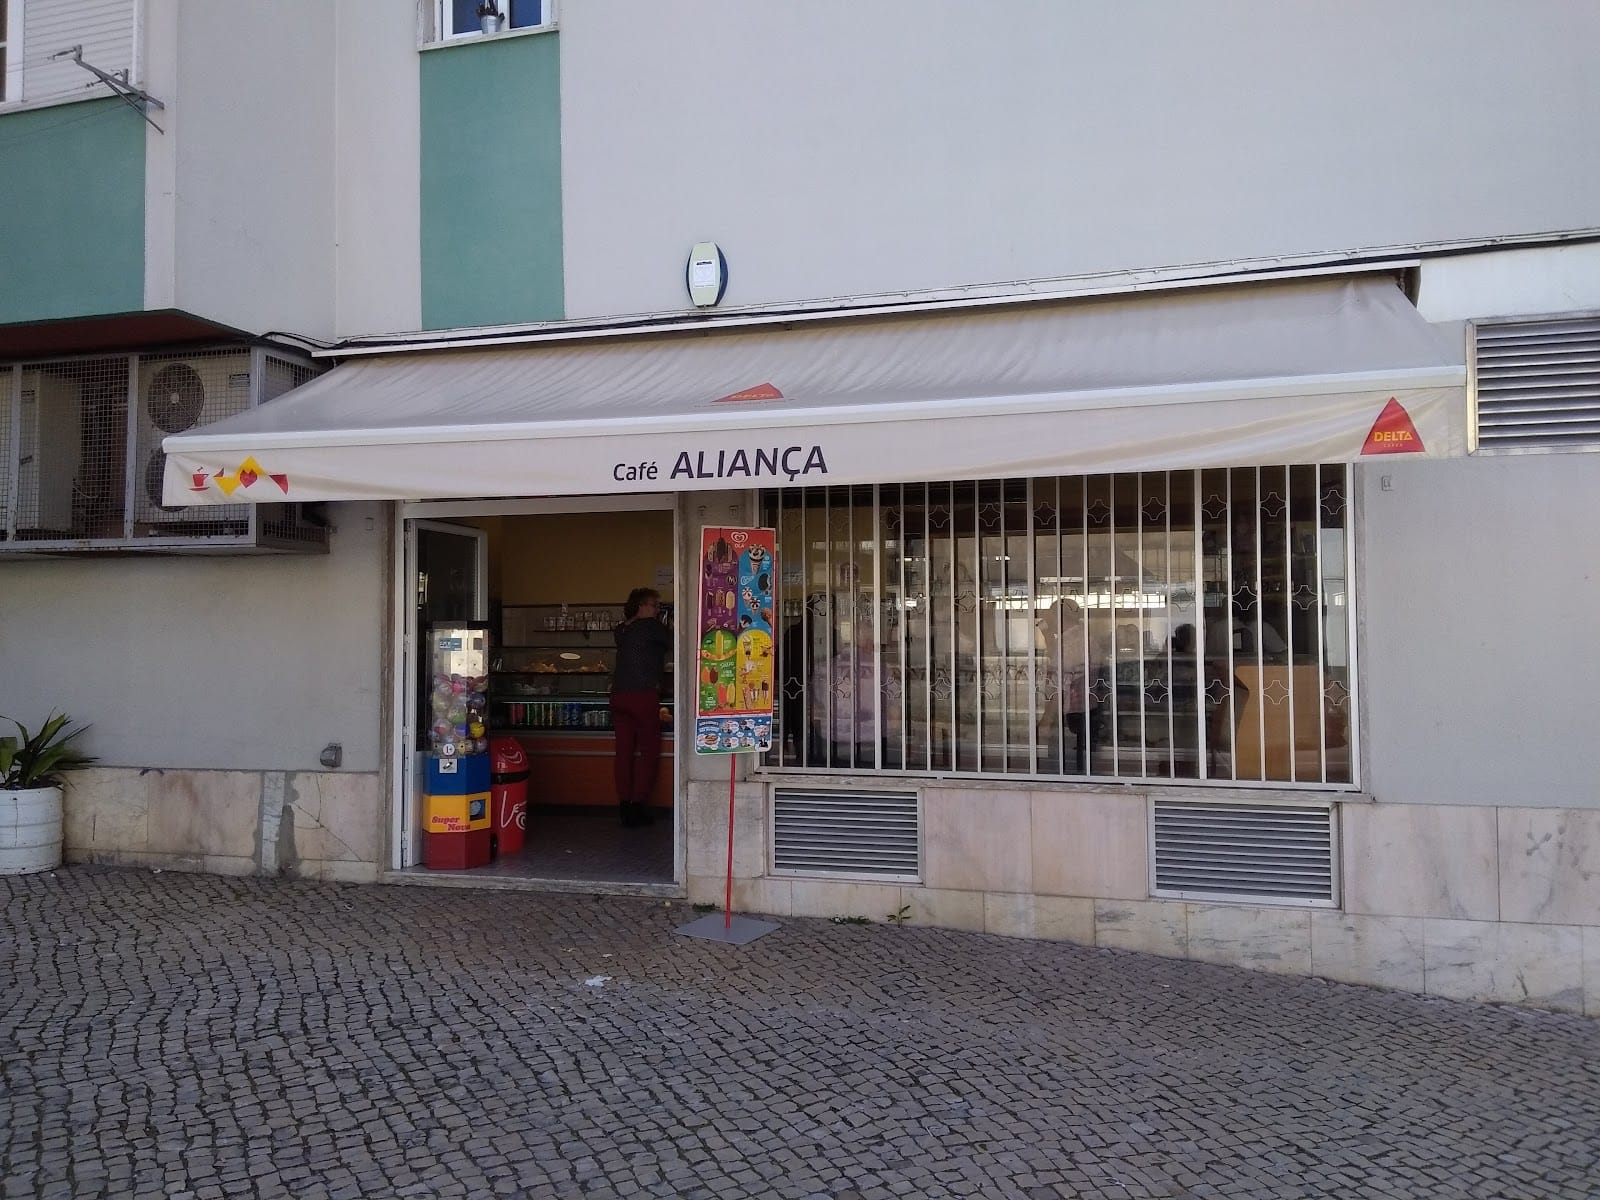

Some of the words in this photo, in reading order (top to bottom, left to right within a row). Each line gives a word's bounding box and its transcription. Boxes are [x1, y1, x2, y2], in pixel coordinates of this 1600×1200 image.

[1374, 430, 1413, 442] DELTA
[613, 462, 658, 481] Café
[670, 446, 828, 481] ALIANÇA
[431, 815, 460, 824] Super
